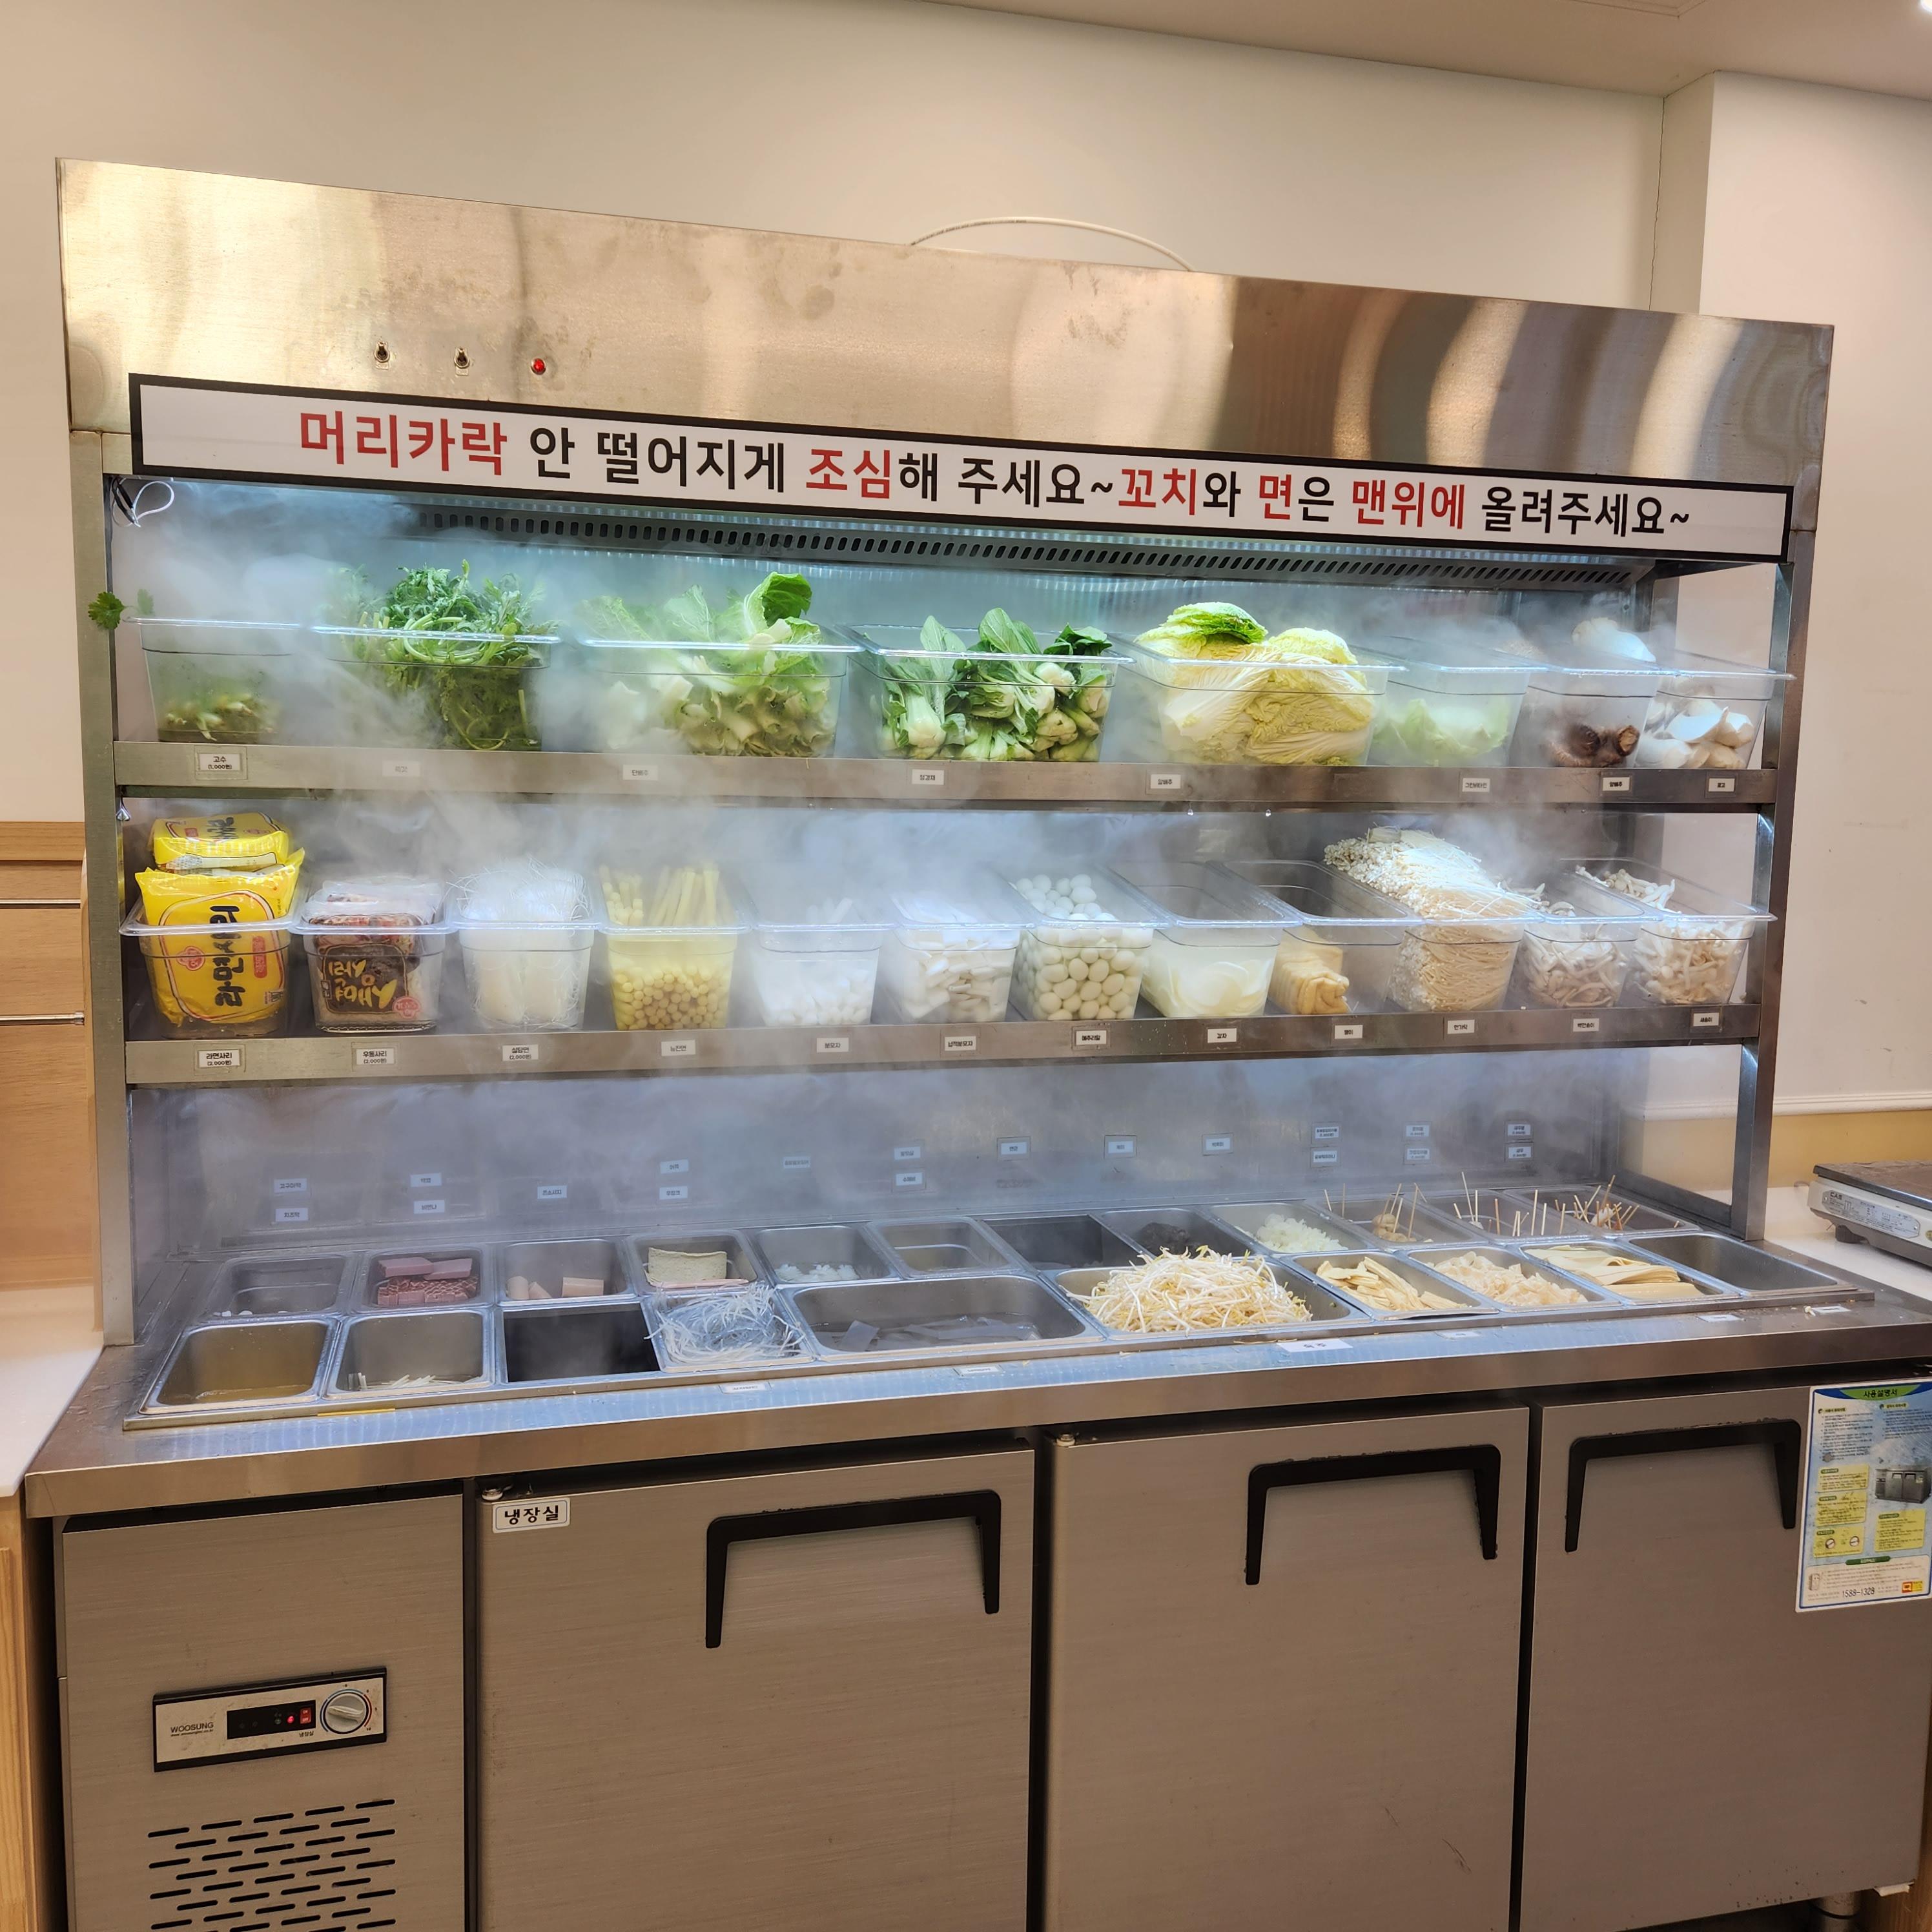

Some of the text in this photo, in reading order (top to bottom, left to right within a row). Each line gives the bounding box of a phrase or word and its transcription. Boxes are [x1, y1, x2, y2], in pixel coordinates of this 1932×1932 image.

[300, 411, 508, 476] 머리카락
[531, 427, 575, 478] 안
[597, 431, 785, 493] 떨어지게
[807, 449, 937, 501] 조심해
[1260, 475, 1334, 522] 면은
[1353, 480, 1464, 529] 맨위에
[1481, 486, 1690, 537] 올려주세요~
[327, 959, 367, 978] 사리
[334, 974, 398, 1009] 생면
[1864, 1389, 1898, 1398] 사용설명서
[504, 1505, 559, 1525] 냉장실
[170, 1721, 214, 1733] WOOSUNG
